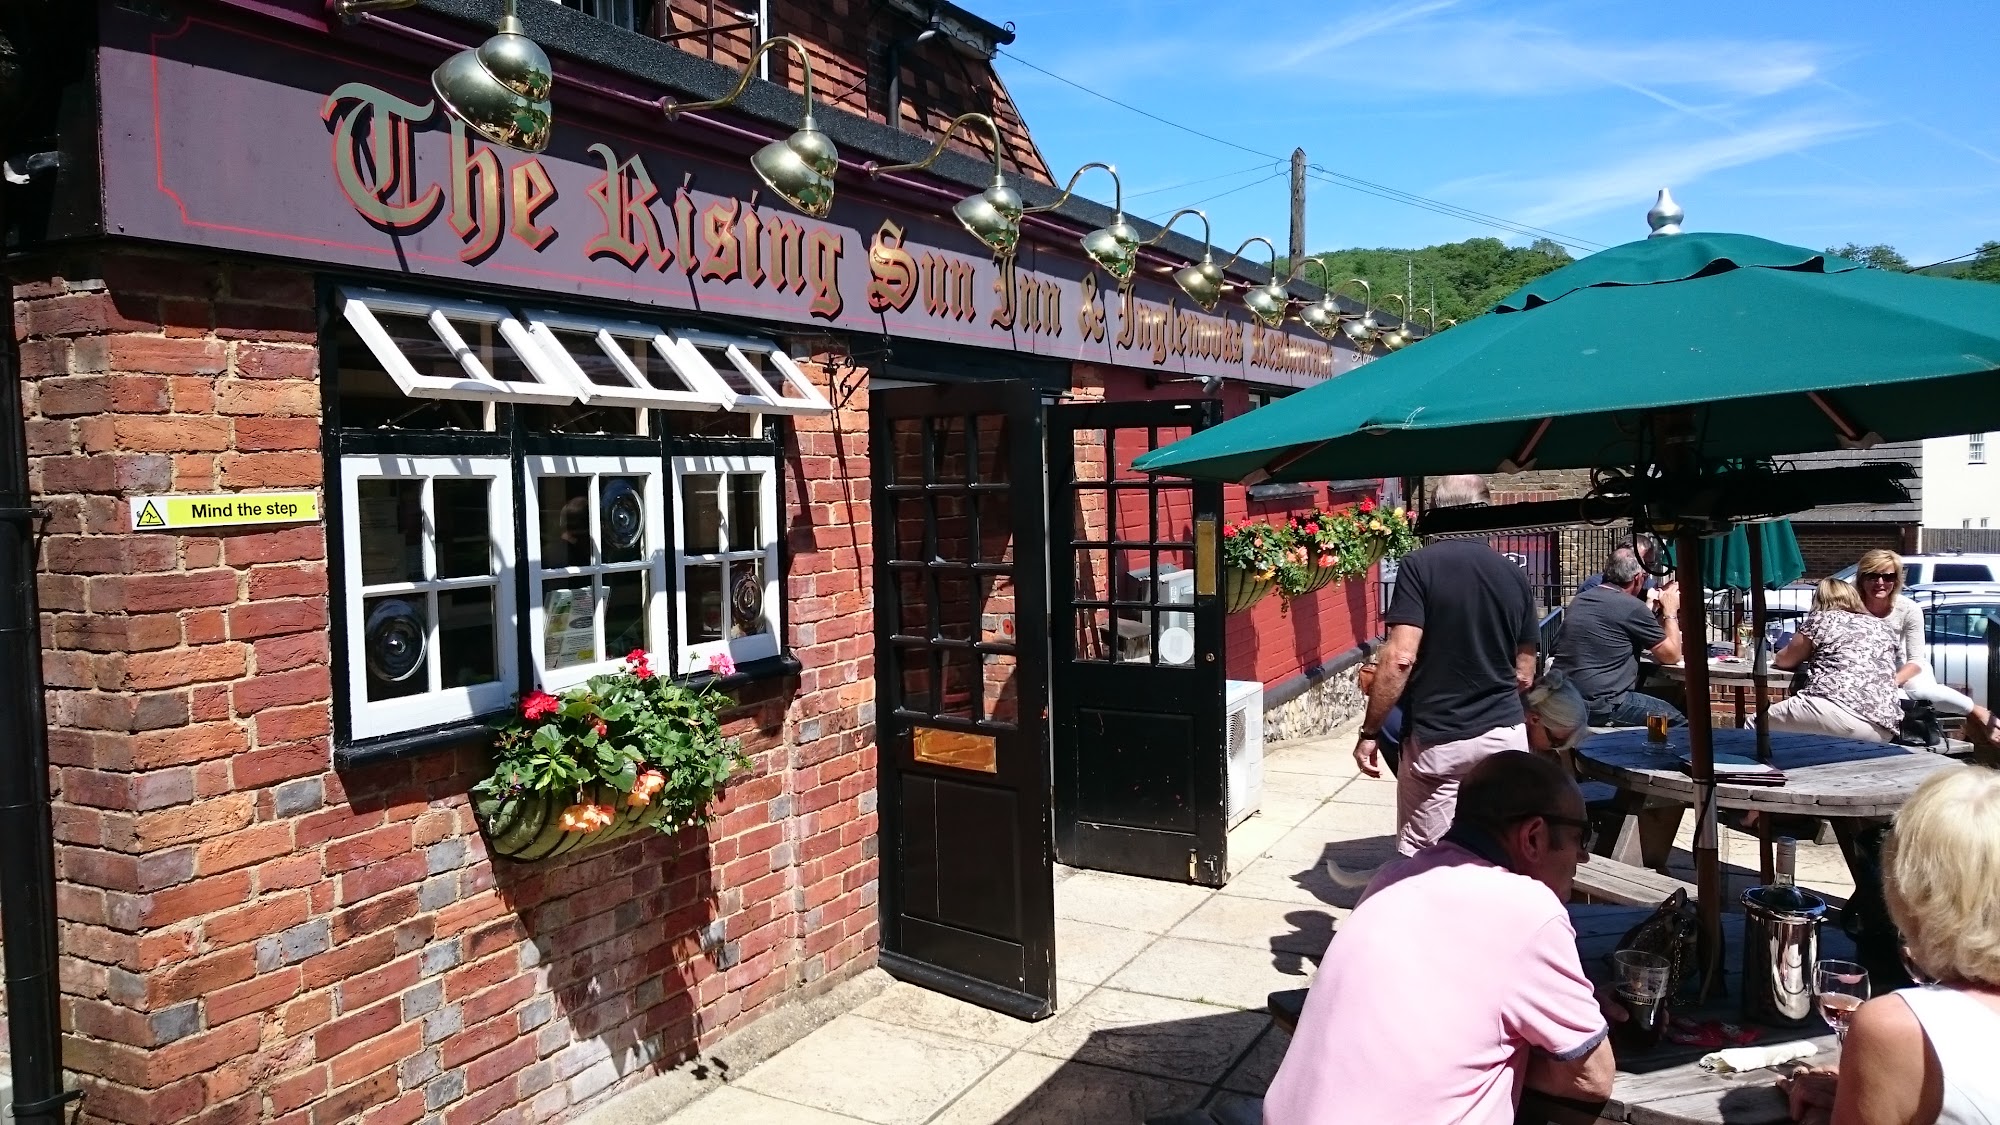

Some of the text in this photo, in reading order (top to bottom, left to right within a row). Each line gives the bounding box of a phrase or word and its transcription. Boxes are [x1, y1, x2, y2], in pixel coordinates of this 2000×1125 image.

[321, 82, 557, 263] The
[585, 143, 843, 318] Rising
[867, 219, 976, 322] Sun
[990, 250, 1062, 338] Inn
[1077, 271, 1105, 343] &
[191, 501, 298, 518] Mind the step
